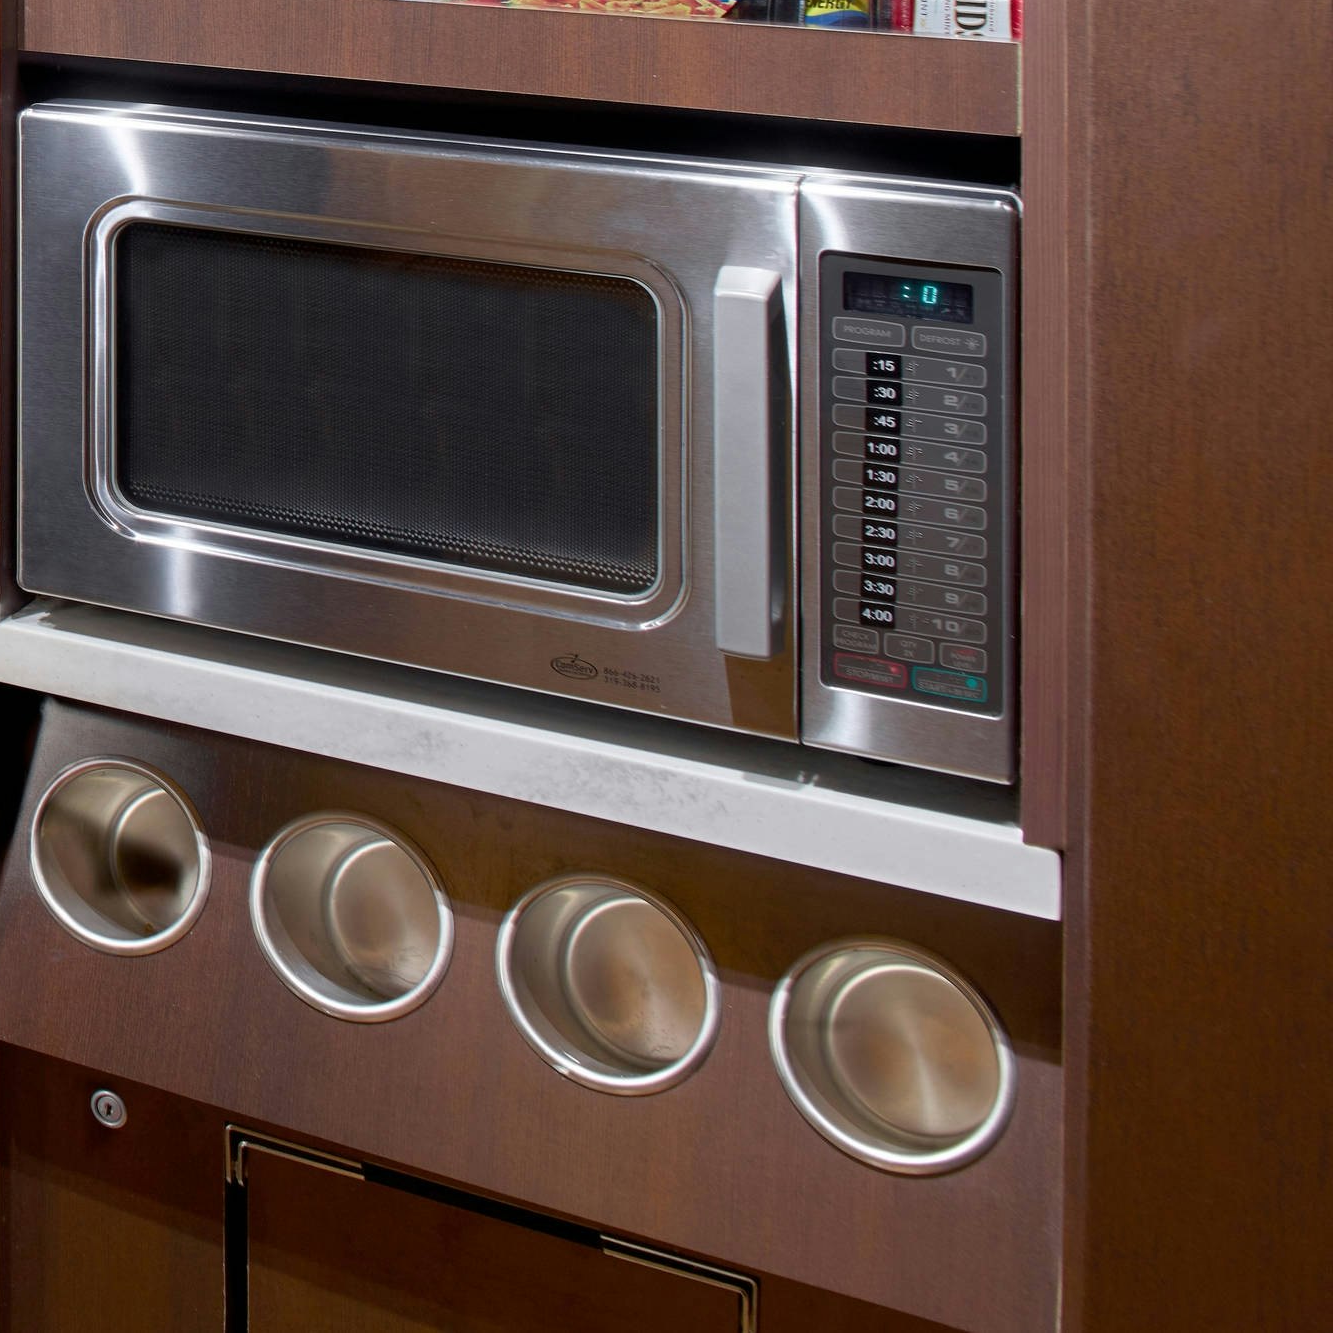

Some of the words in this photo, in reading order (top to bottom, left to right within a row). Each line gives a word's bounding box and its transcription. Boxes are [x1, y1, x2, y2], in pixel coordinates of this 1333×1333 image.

[919, 334, 961, 345] DEFROST
[873, 359, 895, 372] :15
[873, 387, 896, 399] :30
[874, 416, 896, 428] :45
[867, 442, 897, 456] 1:00
[866, 469, 896, 483] 1:30
[865, 496, 895, 511] 2:00
[865, 524, 895, 540] 2:30
[865, 553, 894, 567] 3:00
[864, 580, 894, 595] 3:30
[862, 608, 893, 623] 4:00
